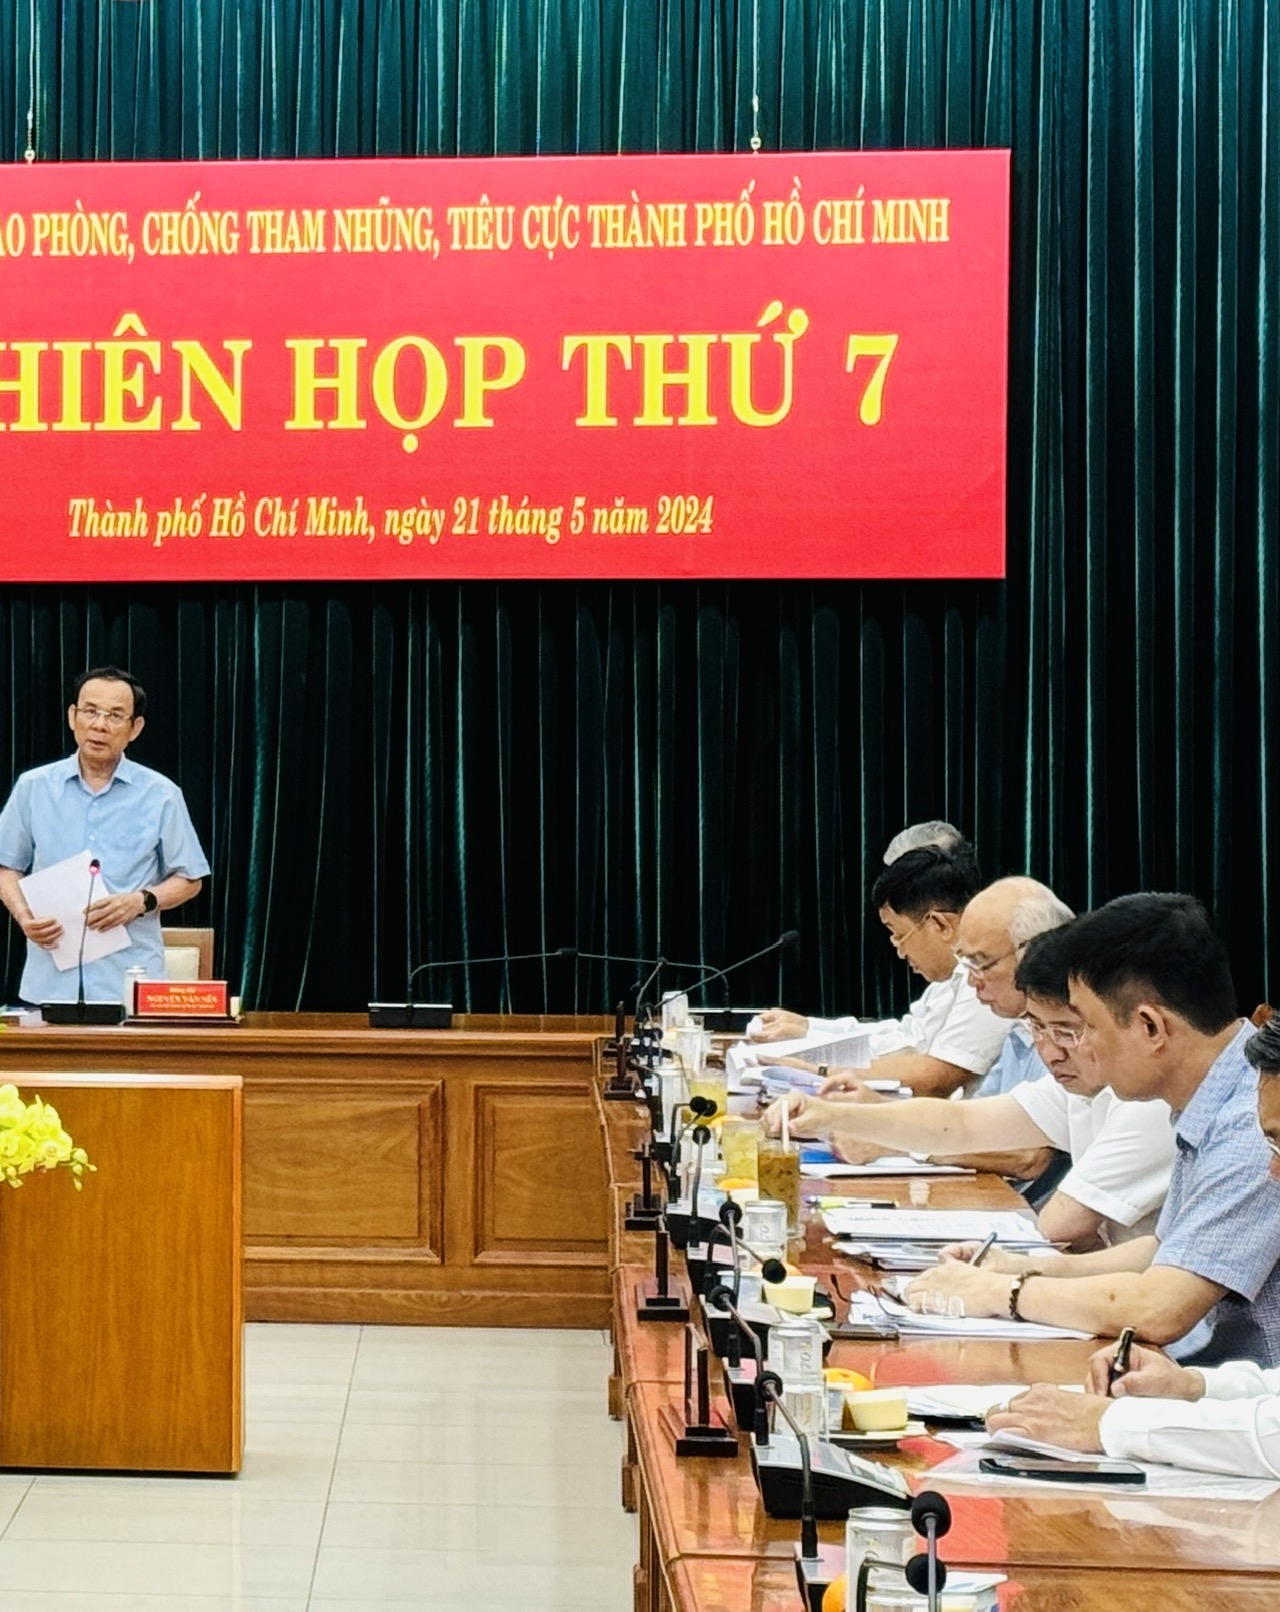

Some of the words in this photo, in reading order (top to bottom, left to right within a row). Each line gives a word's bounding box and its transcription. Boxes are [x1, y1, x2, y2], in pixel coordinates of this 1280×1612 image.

[30, 198, 136, 265] PHÒNG,
[141, 190, 241, 257] CHỐNG
[245, 208, 328, 255] THAM
[332, 195, 441, 261] NHŨNG,
[445, 193, 516, 252] TIÊU
[522, 195, 582, 261] CỰC
[586, 189, 689, 249] THÀNH
[693, 178, 756, 247] PHỐ
[761, 175, 807, 246] HỒ
[809, 183, 866, 246] CHÍ
[870, 196, 951, 245] MINH
[283, 334, 527, 454] HỌP
[561, 299, 810, 427] THỨ
[845, 333, 900, 426] 7
[68, 497, 149, 538] Thành
[153, 491, 207, 547] phố
[208, 489, 247, 538] Hồ
[253, 496, 300, 538] Chí
[303, 495, 376, 544] Minh,
[384, 495, 446, 545] ngày
[451, 496, 480, 535] 21
[487, 494, 565, 545] tháng
[569, 496, 587, 535] 5
[592, 494, 650, 535] năm
[655, 494, 714, 535] 2024
